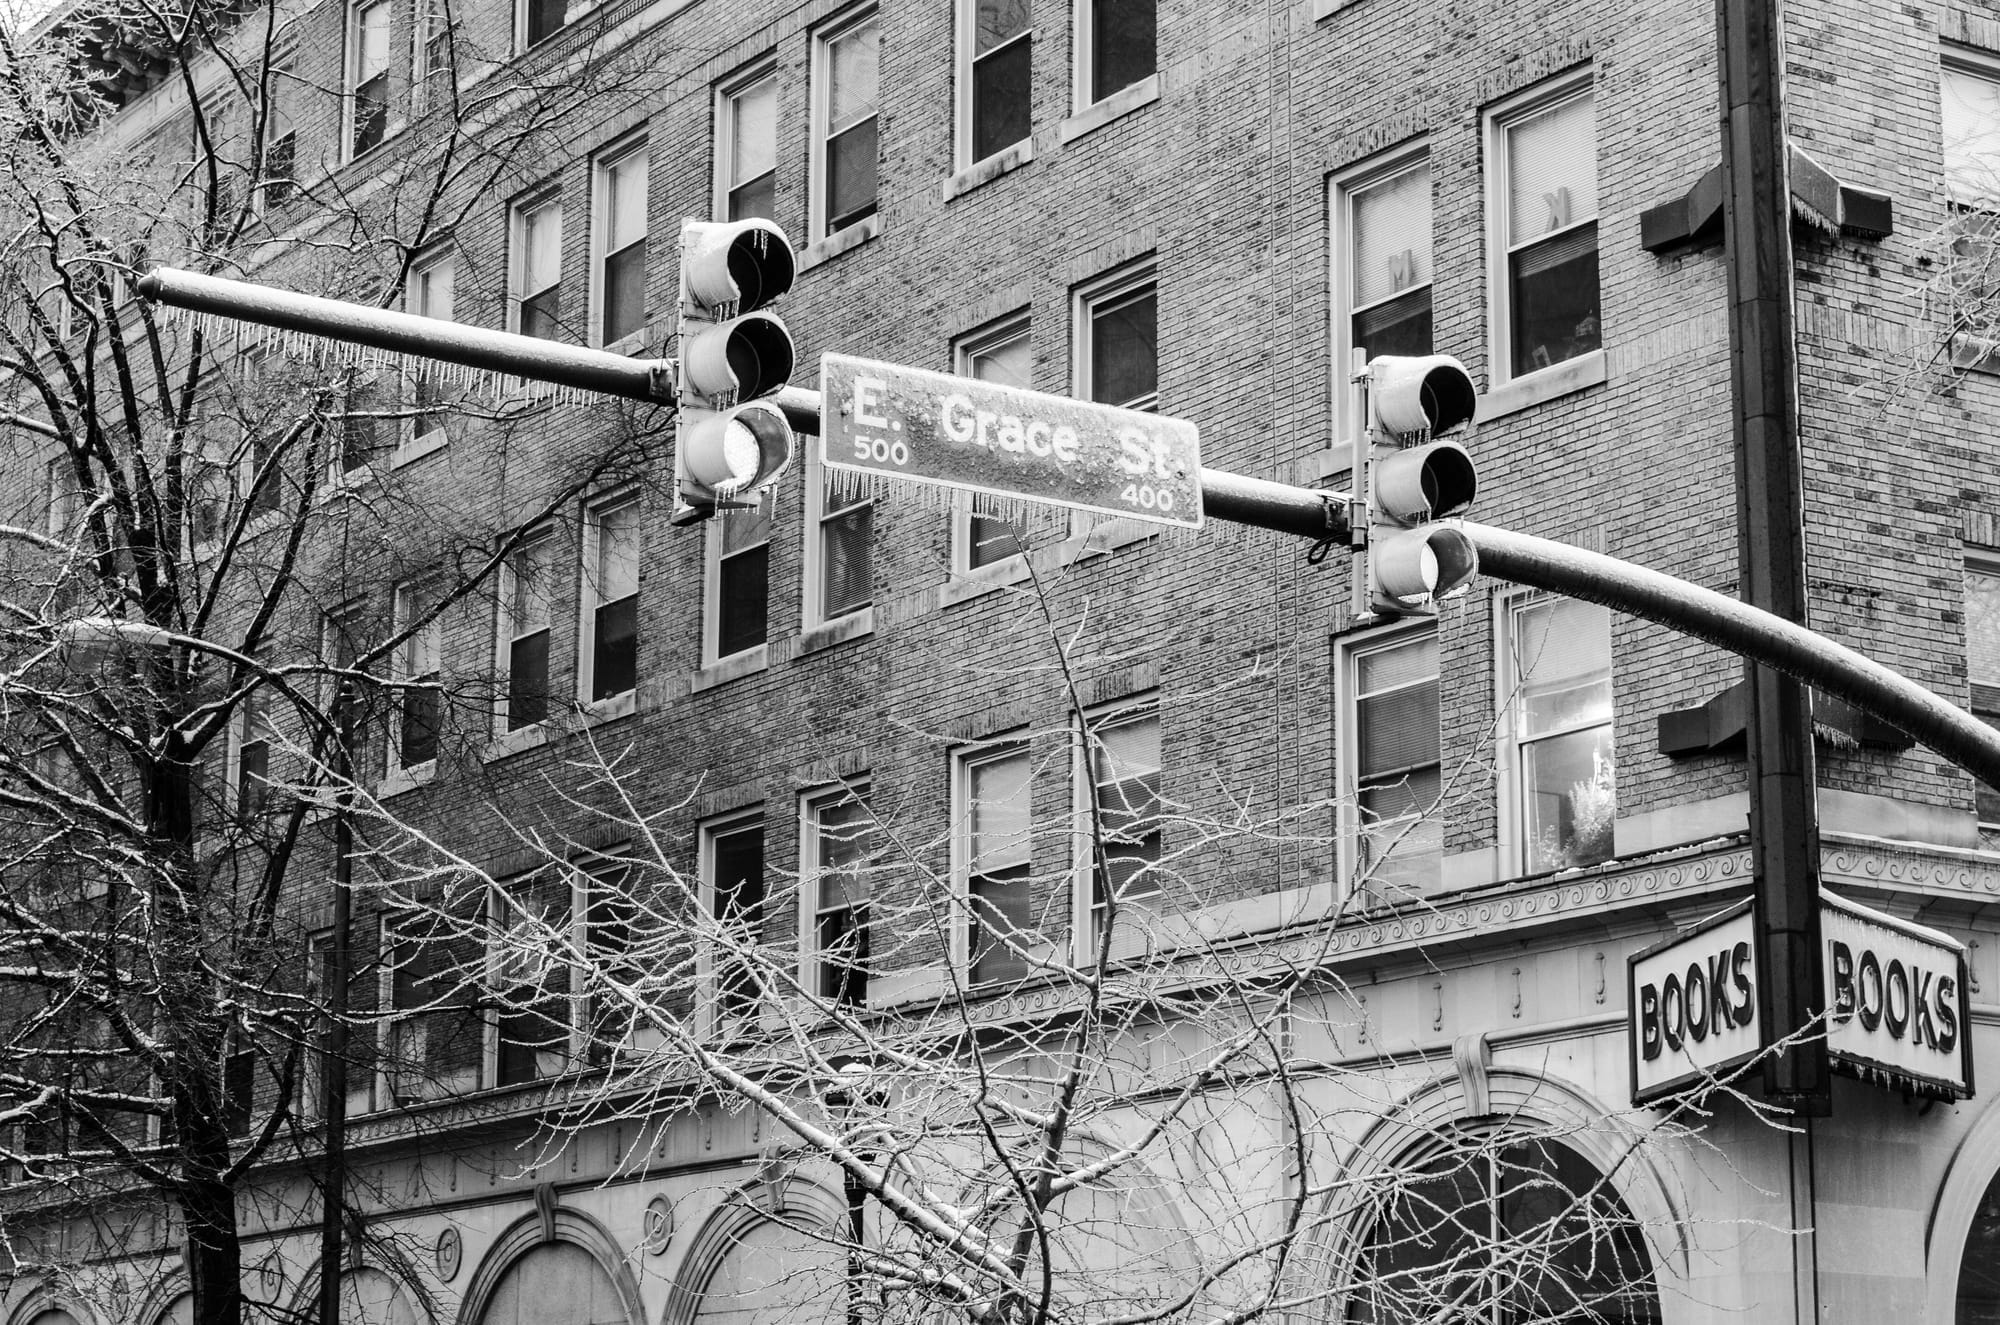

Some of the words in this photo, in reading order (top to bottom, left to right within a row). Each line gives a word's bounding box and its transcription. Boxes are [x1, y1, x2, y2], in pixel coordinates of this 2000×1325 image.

[854, 376, 901, 432] E.
[942, 394, 1079, 462] Grace
[854, 435, 909, 466] 500
[1121, 483, 1174, 512] 400
[1640, 941, 1755, 1061] BOOKS
[1828, 939, 1957, 1054] BOOKS
